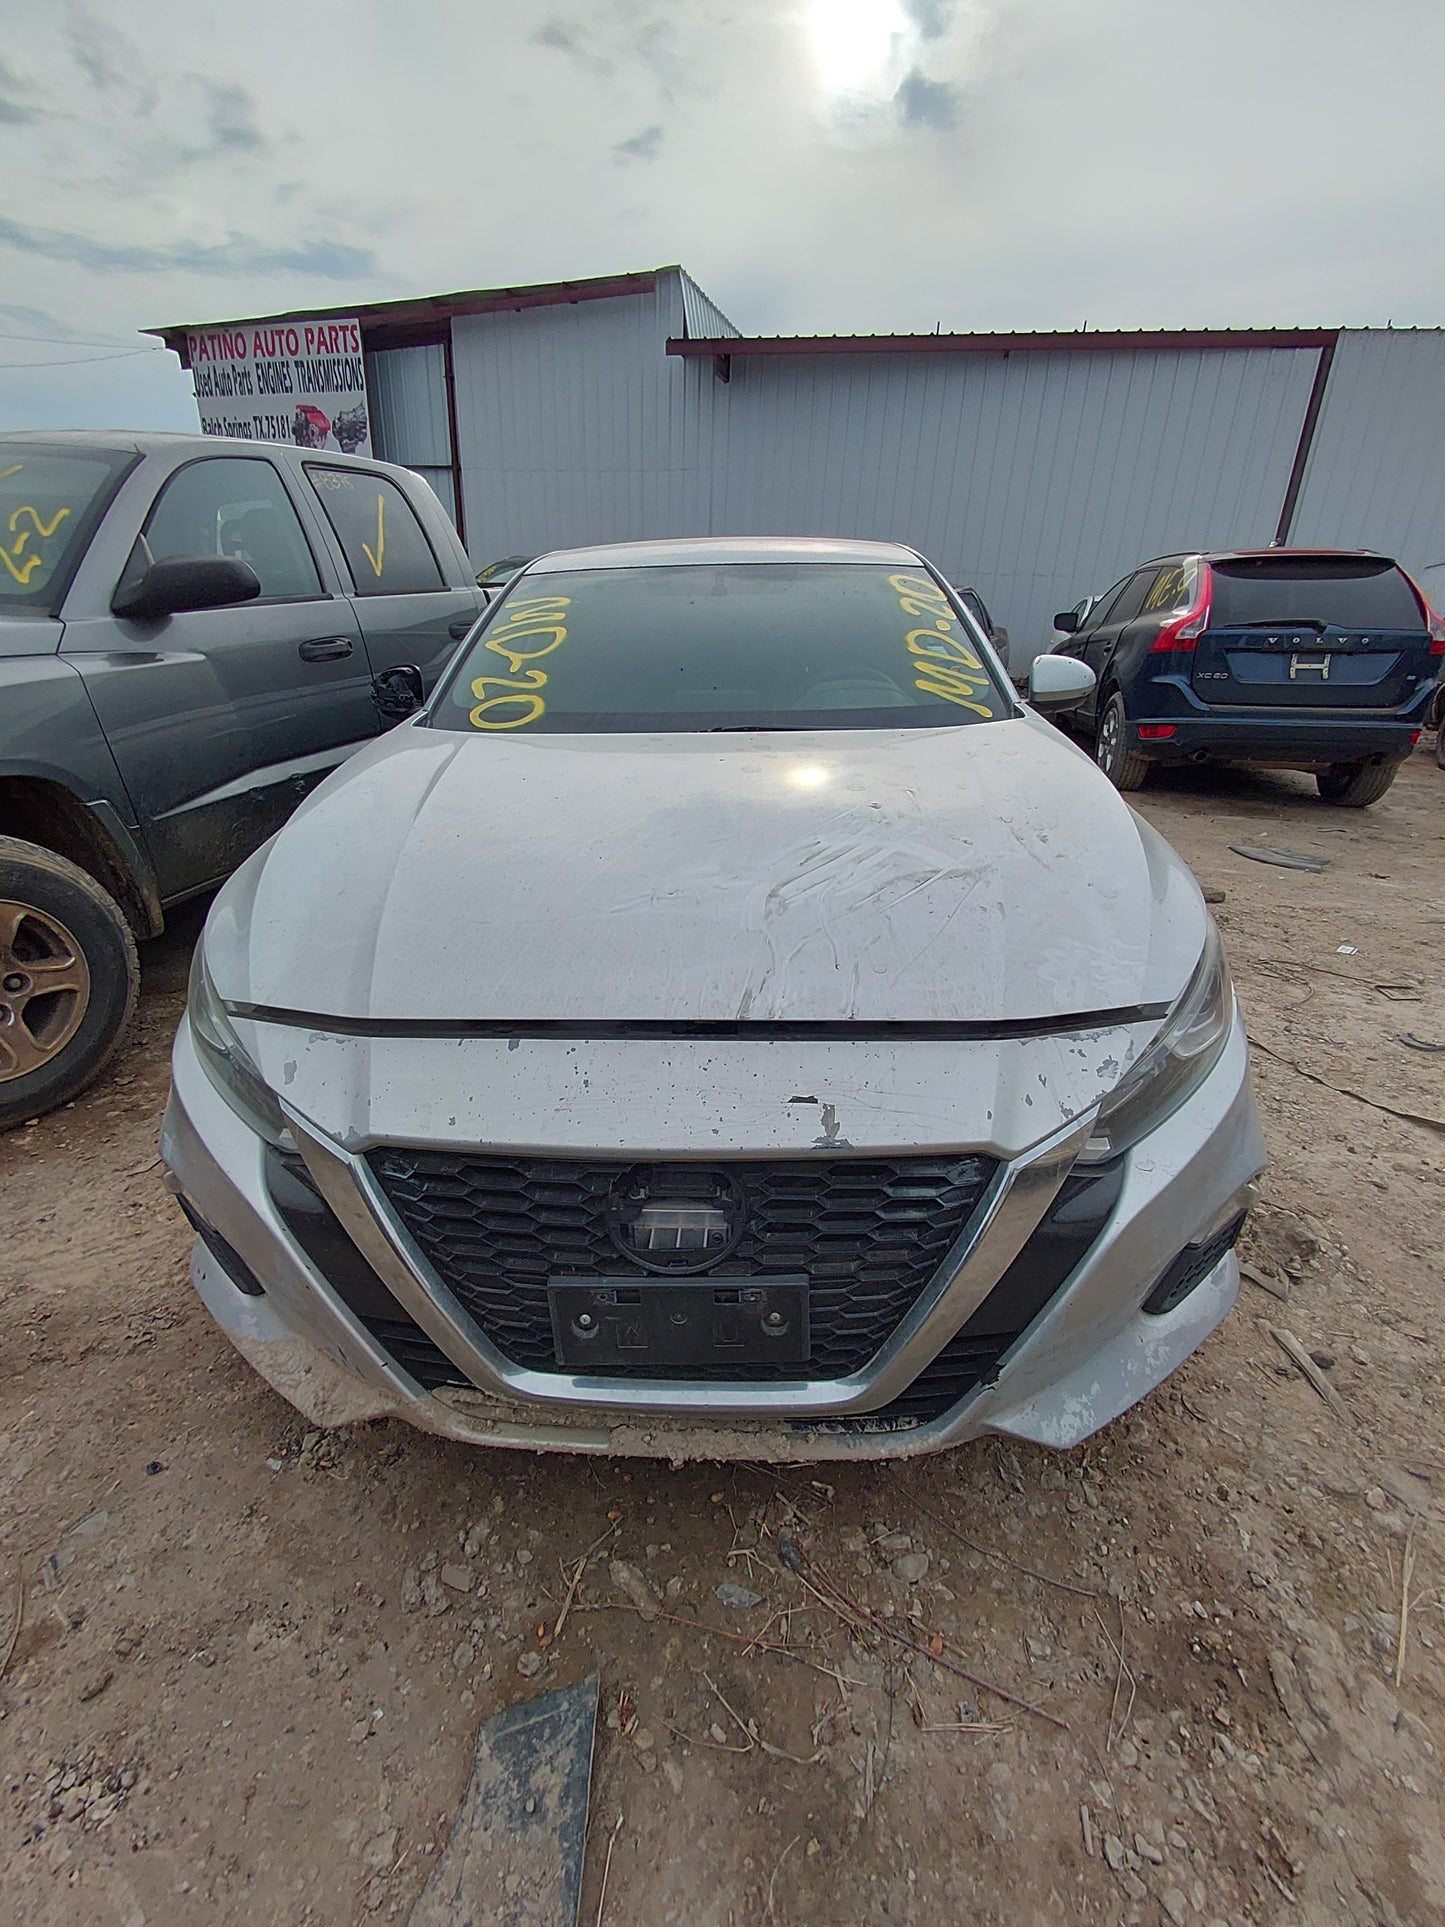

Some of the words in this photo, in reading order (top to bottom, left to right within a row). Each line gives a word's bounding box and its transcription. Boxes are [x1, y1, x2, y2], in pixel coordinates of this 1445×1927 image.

[188, 329, 247, 362] PATIÑO
[253, 328, 299, 358] AUTO
[304, 324, 360, 355] PARTS
[193, 365, 213, 397] Used
[213, 365, 233, 397] Auto
[231, 364, 253, 396] Parts
[255, 360, 293, 395] ENGINES
[294, 357, 364, 393] TRANSMISSIONS
[1267, 636, 1370, 645] VOLVO
[1196, 672, 1229, 680] XC60
